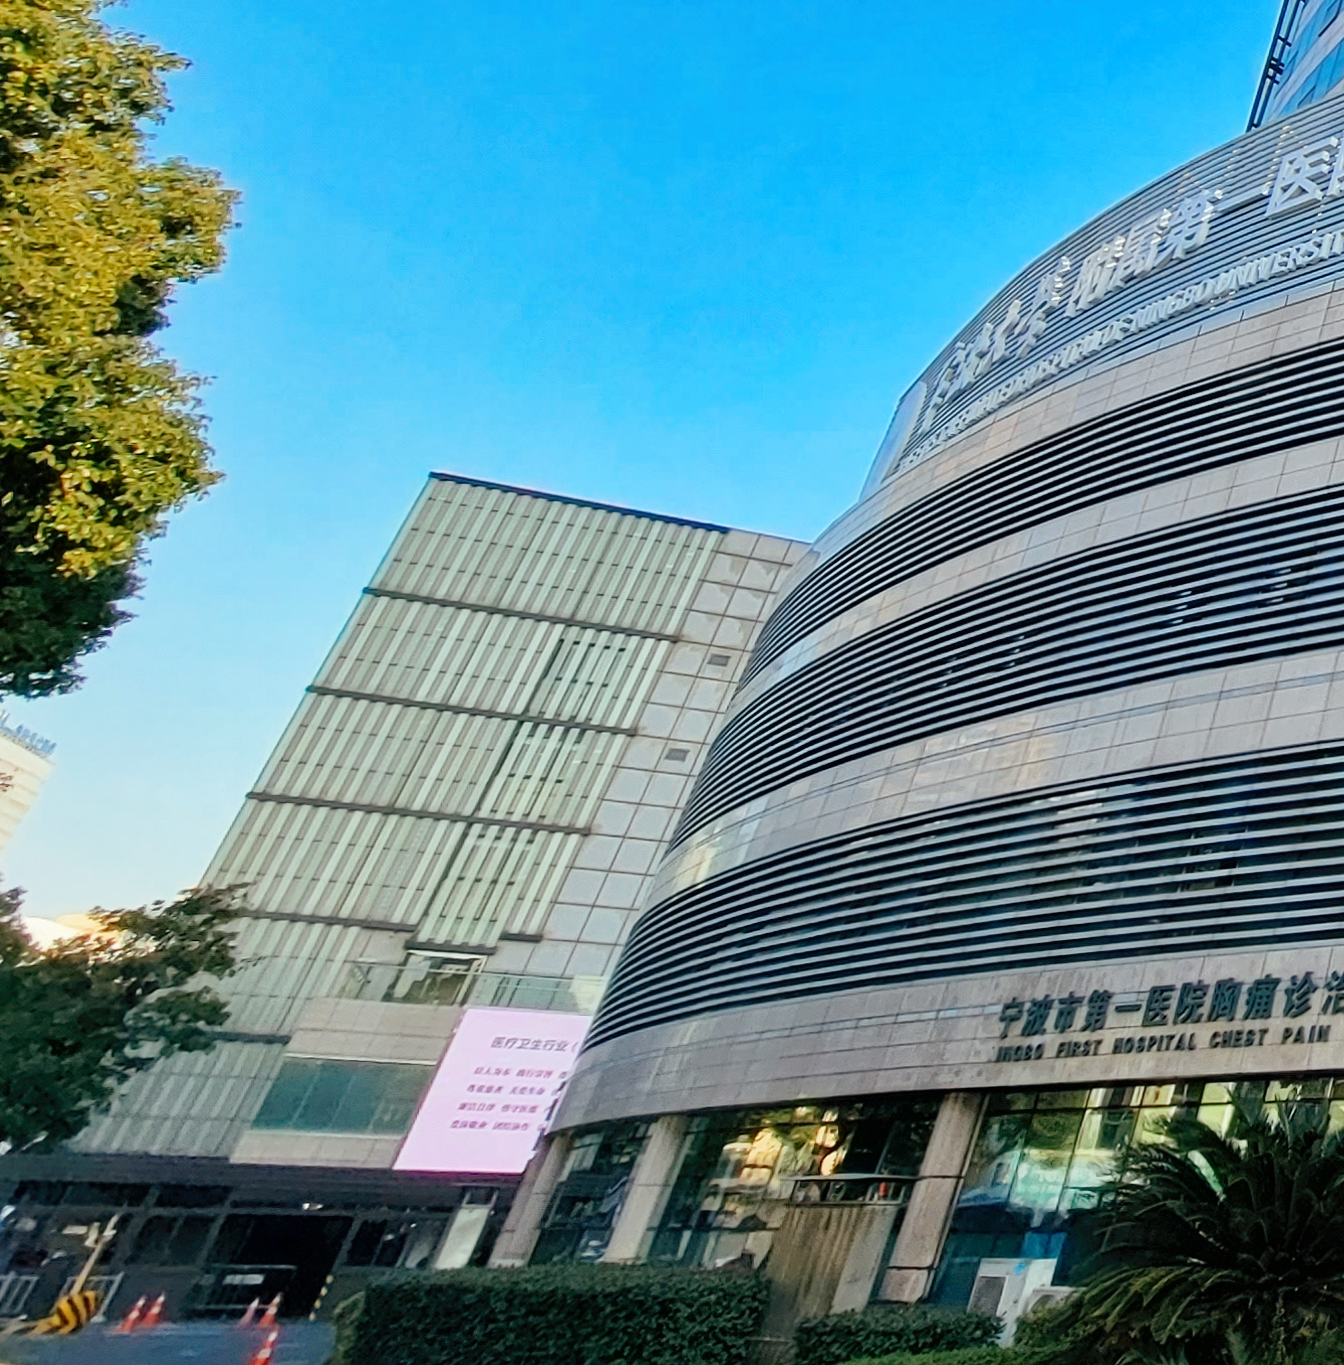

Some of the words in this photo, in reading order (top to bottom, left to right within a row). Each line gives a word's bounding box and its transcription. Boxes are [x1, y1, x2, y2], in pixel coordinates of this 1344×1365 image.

[1056, 1038, 1103, 1058] FIRST
[1111, 1032, 1197, 1054] HOSPITAL
[1209, 1027, 1269, 1048] CHEST
[1280, 1024, 1332, 1044] PAIN
